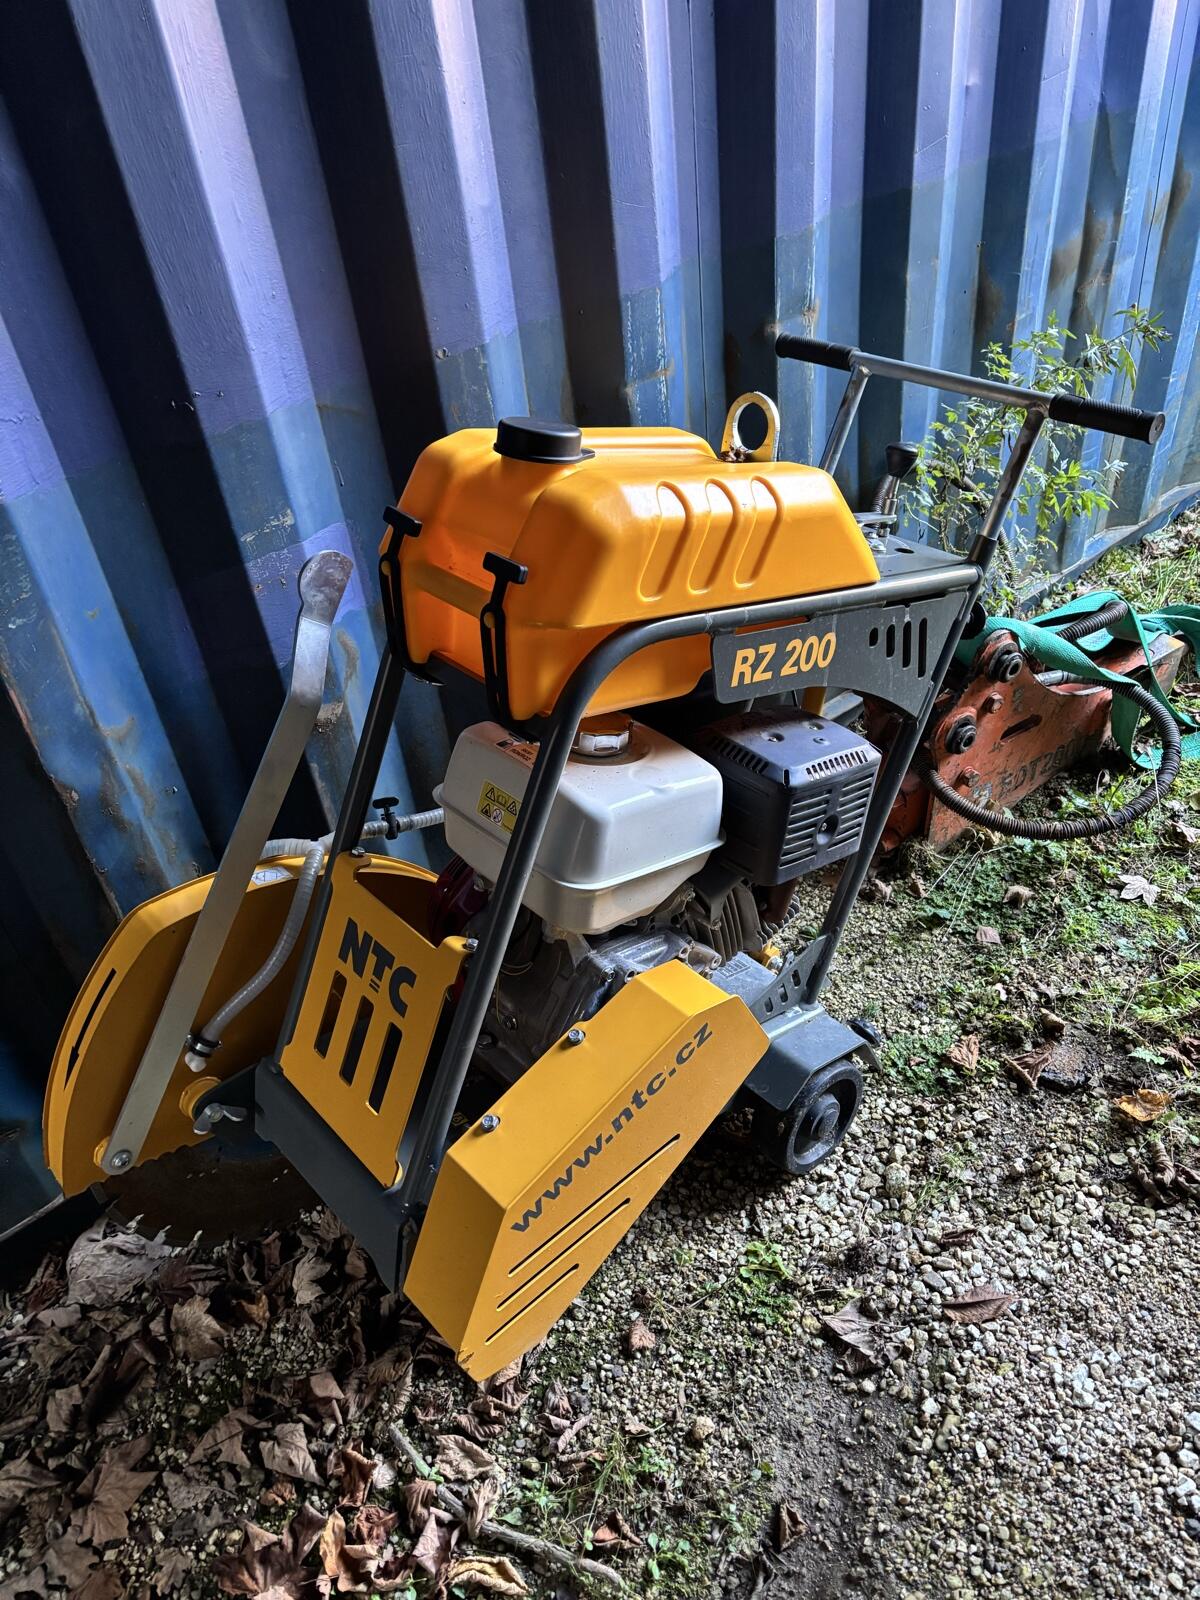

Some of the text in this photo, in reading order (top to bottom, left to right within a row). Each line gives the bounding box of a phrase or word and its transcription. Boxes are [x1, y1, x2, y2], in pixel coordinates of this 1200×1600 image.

[730, 631, 837, 688] RZ 200
[338, 916, 417, 1019] NTC
[510, 1022, 713, 1233] www.ntc.cz
